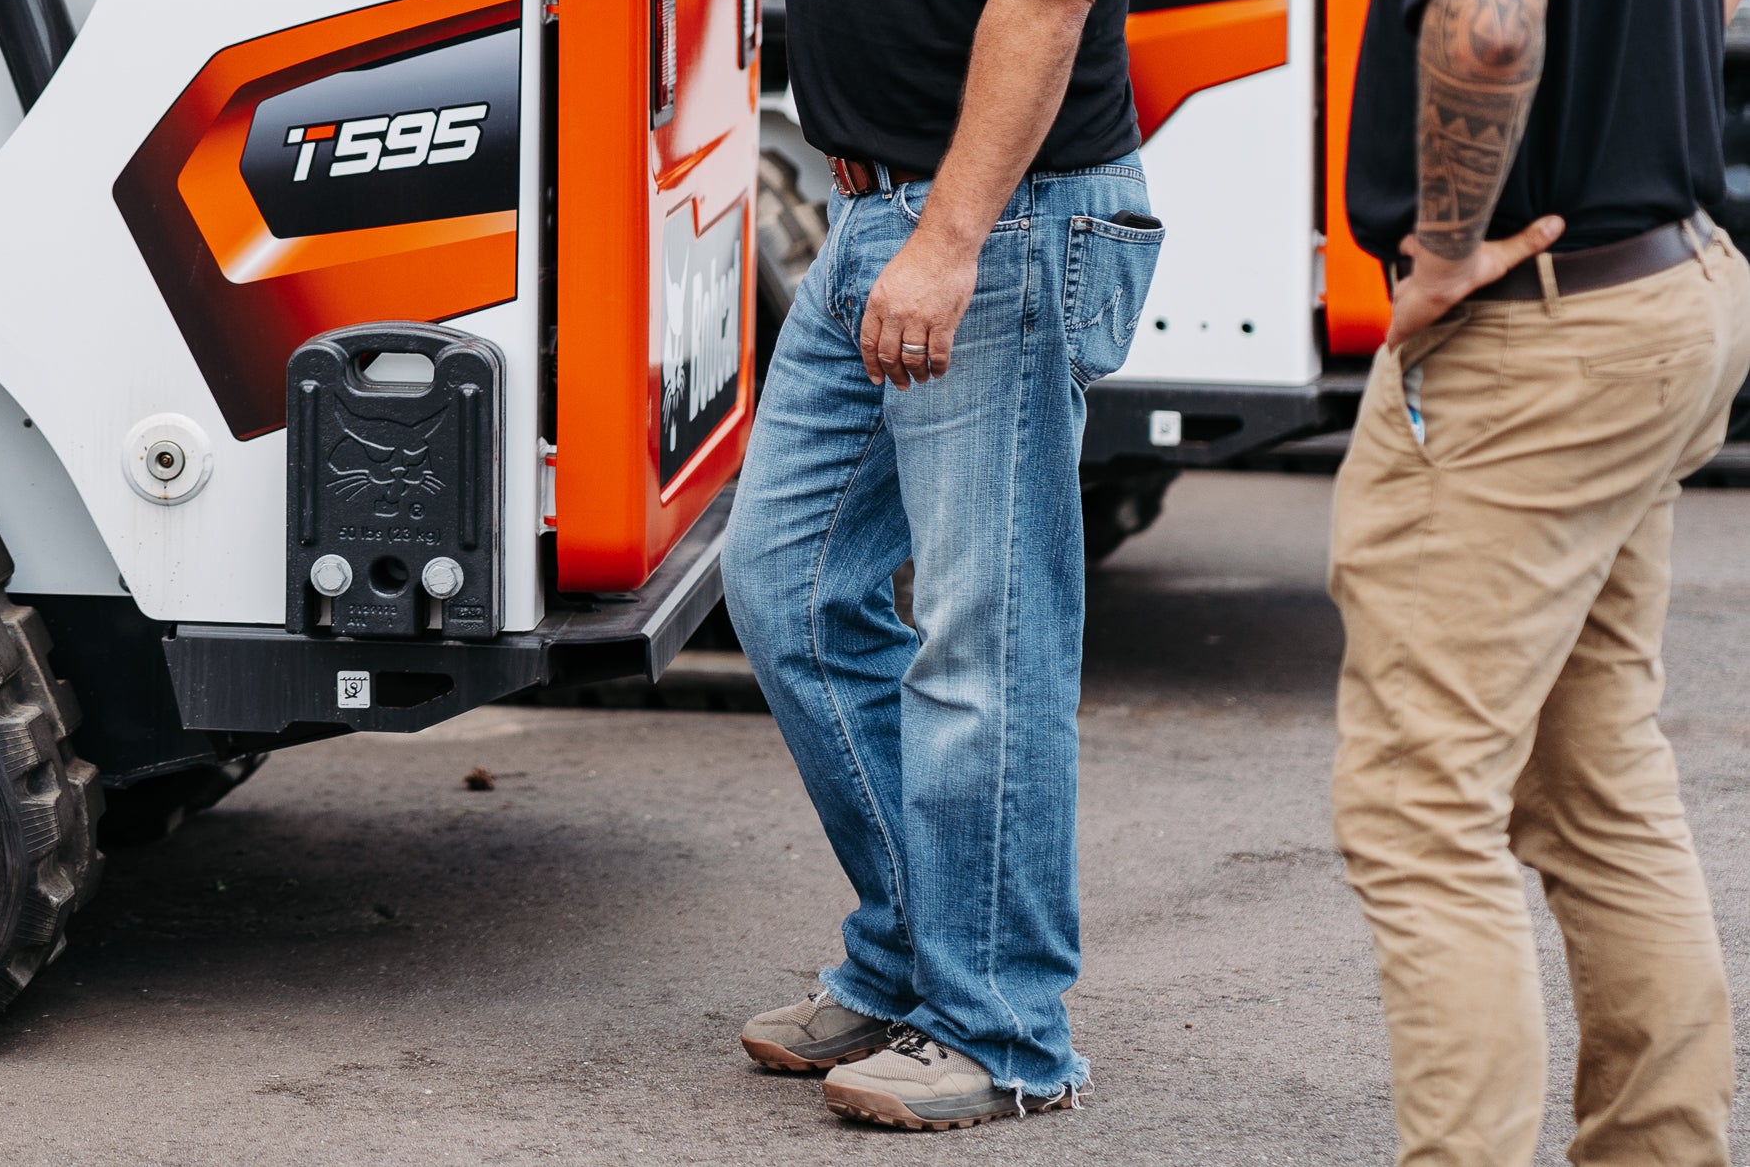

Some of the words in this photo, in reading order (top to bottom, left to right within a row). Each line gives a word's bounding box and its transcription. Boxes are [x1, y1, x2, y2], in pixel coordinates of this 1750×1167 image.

[286, 103, 489, 182] T595
[361, 525, 383, 541] lbs
[388, 526, 411, 545] (23
[415, 525, 441, 546] kg)
